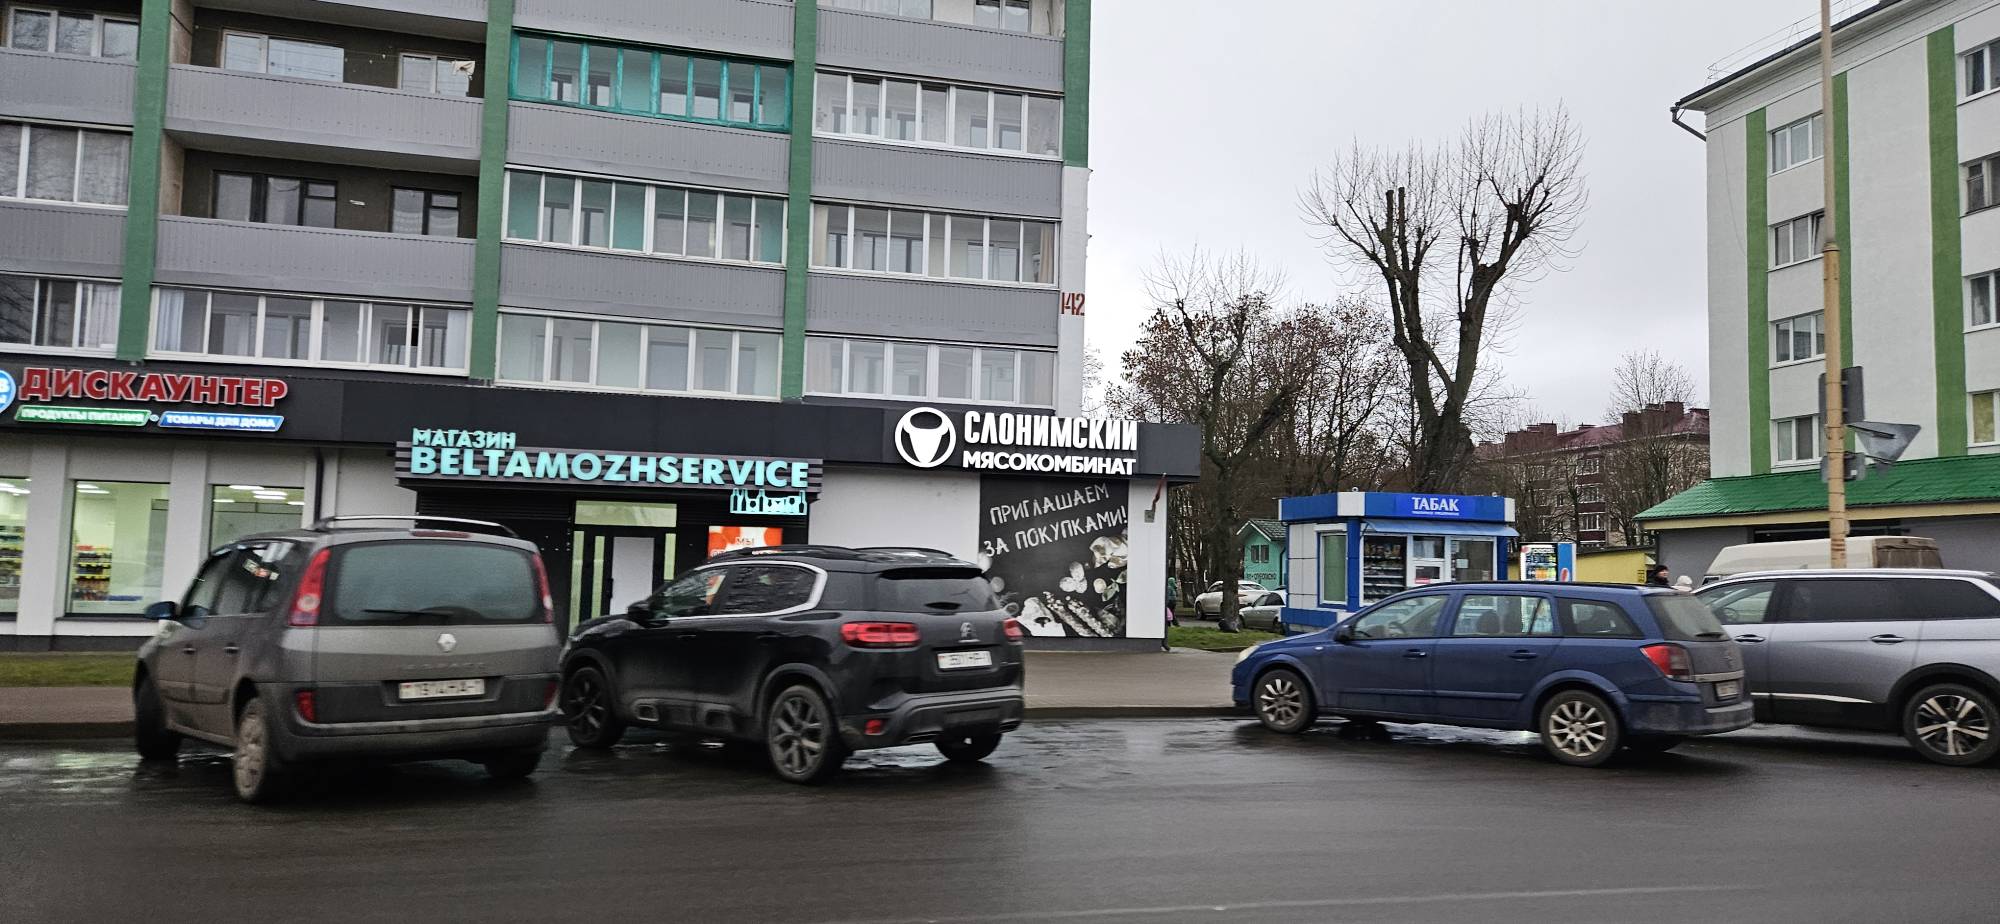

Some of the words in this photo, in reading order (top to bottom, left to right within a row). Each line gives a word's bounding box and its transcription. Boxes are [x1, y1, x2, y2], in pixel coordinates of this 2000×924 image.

[1061, 292, 1085, 316] 142
[19, 367, 288, 407] ДИСКАУНТЕР
[21, 408, 87, 420] ПРОДУКТЫ
[88, 410, 145, 422] ПИТАНИЯ
[166, 415, 215, 425] ТОВАРЫ
[215, 416, 240, 427] ДЛЯ
[240, 418, 276, 428] ДОМА
[412, 428, 517, 449] МАГАЗИН
[411, 446, 809, 488] BELTAMOZHSERVICE
[963, 450, 1137, 475] МЯСОКОМБИНАТ
[989, 483, 1110, 526] ПРИГЛАШАЕМ
[1411, 497, 1460, 511] ТАБАК
[735, 537, 755, 545] МЫ
[983, 537, 1010, 557] ЗА
[1014, 505, 1128, 550] ПОКУПКАМИ!
